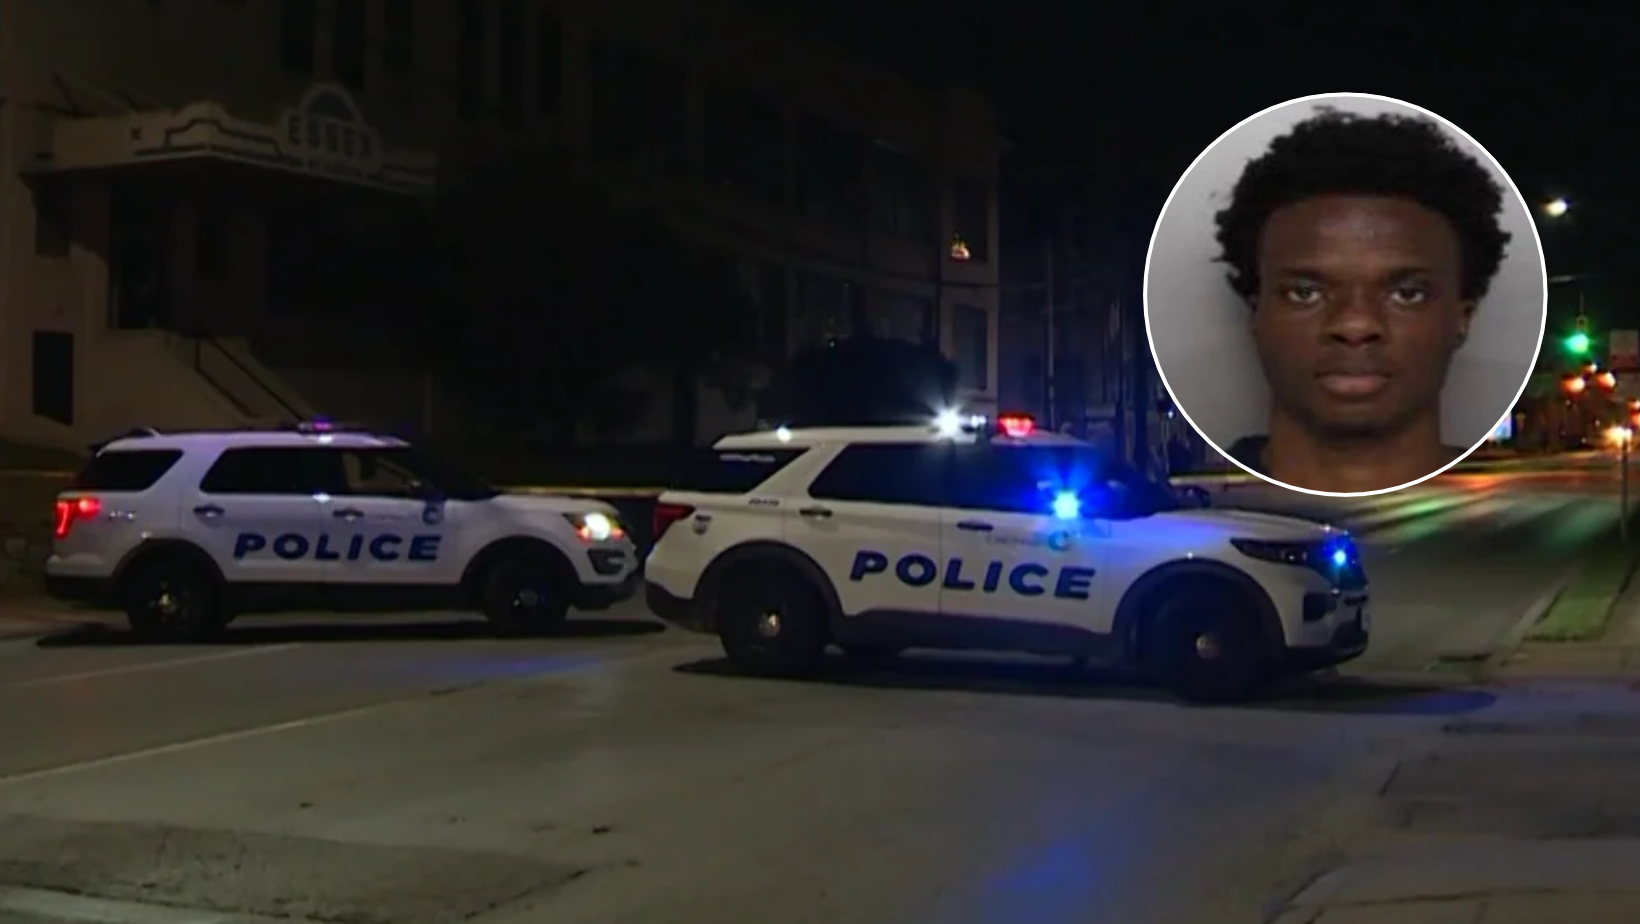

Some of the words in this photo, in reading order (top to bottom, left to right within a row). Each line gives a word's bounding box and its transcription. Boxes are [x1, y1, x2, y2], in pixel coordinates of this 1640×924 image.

[288, 114, 371, 159] ESSEX
[233, 533, 442, 561] POLICE
[849, 550, 1096, 600] POLICE
